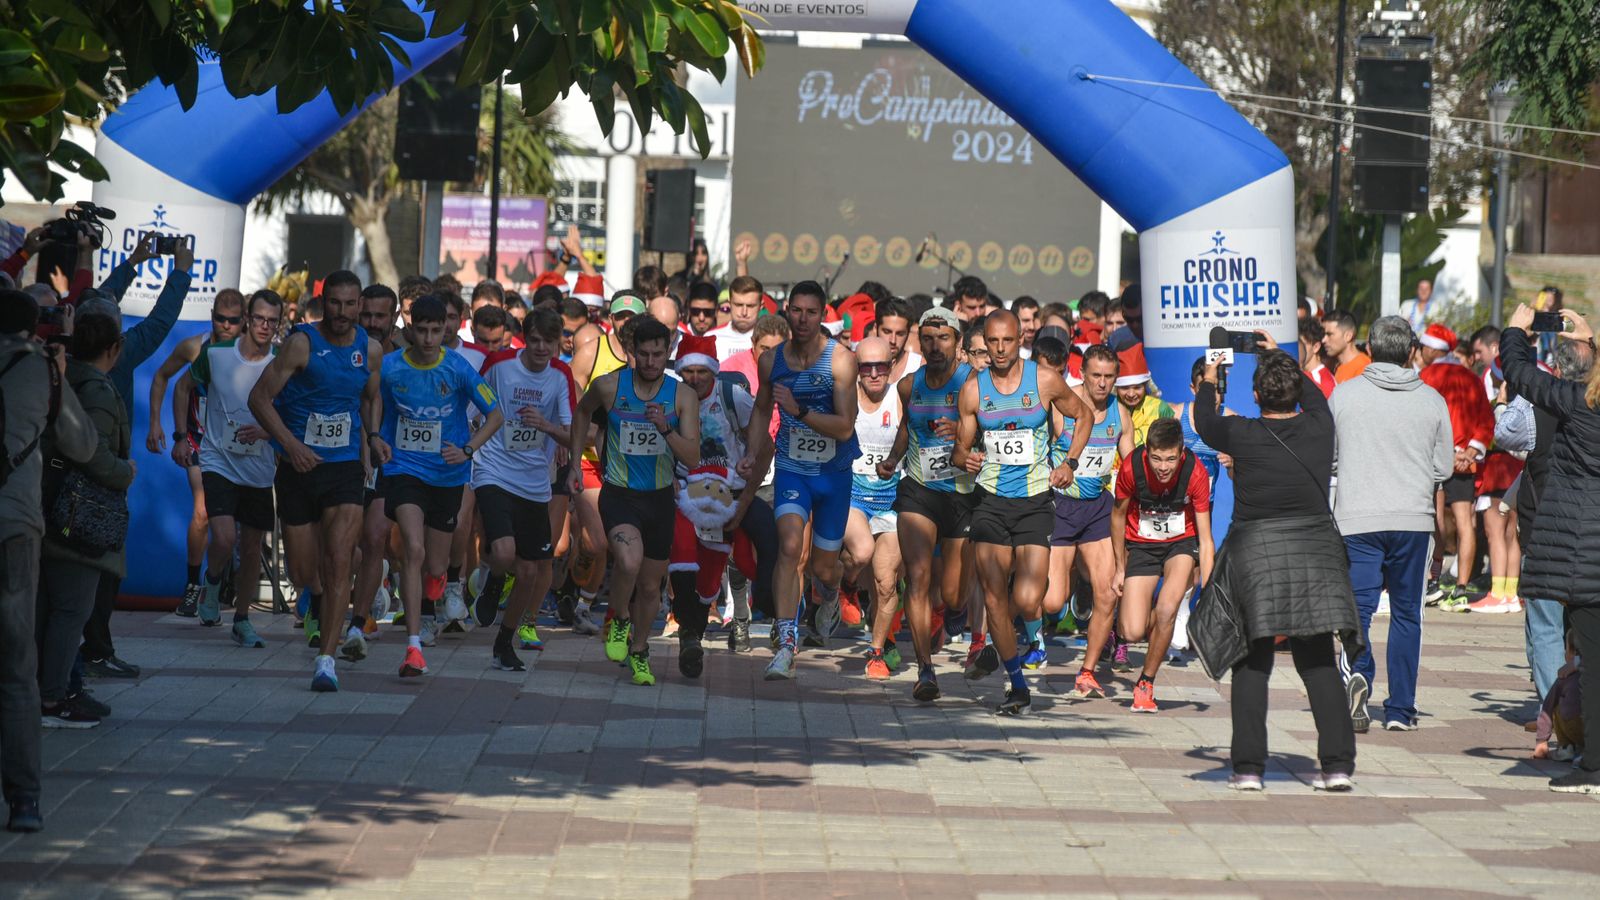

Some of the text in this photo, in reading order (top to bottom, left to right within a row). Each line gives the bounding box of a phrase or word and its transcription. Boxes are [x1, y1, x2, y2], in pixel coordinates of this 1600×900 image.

[774, 3, 793, 14] DE
[797, 4, 865, 15] EVENTOS
[952, 129, 1033, 165] 2024
[1012, 251, 1030, 265] 10
[1044, 251, 1058, 266] 11
[1072, 254, 1089, 268] 12
[1184, 257, 1257, 283] CRONO
[1160, 281, 1281, 319] FINISHER
[316, 423, 343, 438] 138
[403, 428, 432, 442] 190
[511, 429, 537, 442] 201
[628, 431, 657, 446] 192
[797, 438, 827, 453] 229
[994, 440, 1024, 455] 163
[1086, 455, 1103, 468] 74
[1152, 520, 1170, 534] 51
